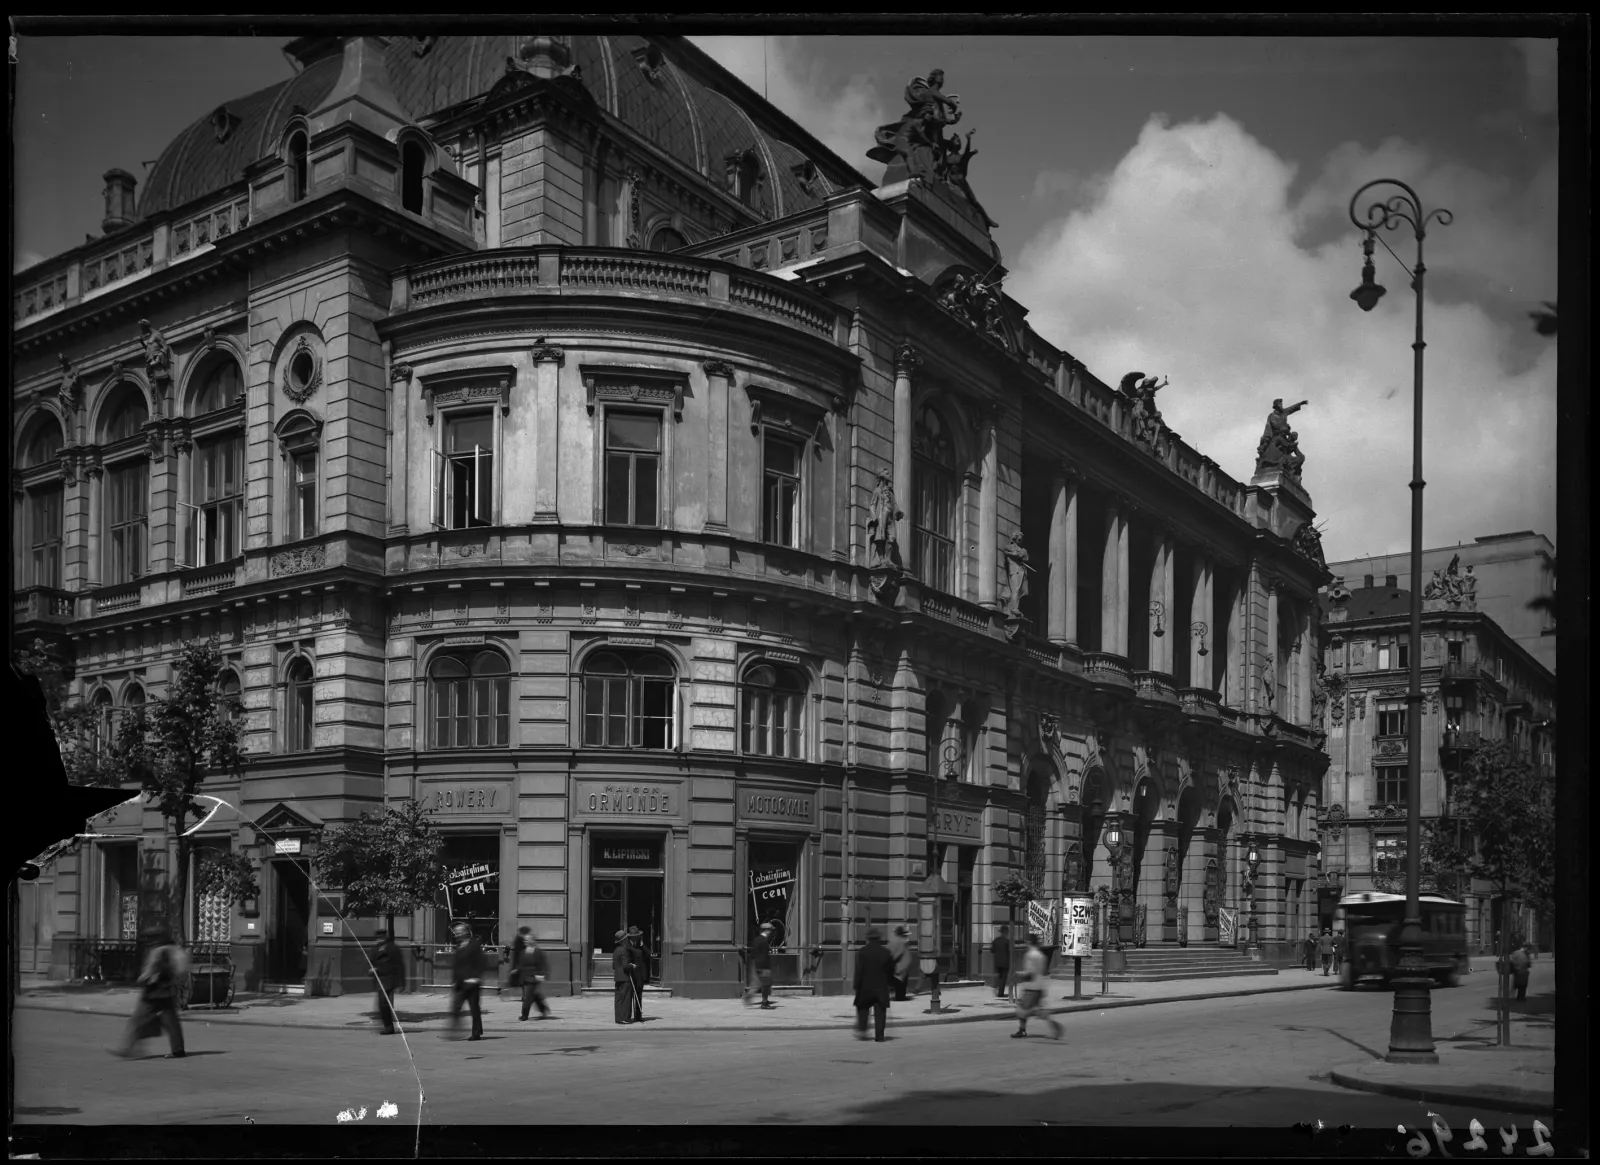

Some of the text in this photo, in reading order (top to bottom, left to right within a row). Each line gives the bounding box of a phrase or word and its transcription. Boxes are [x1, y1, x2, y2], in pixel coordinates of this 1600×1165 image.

[605, 786, 660, 794] MAISON
[436, 789, 497, 808] ROWERY
[588, 793, 669, 812] ORMONDE
[747, 795, 809, 817] MOTOCYKLE
[457, 882, 486, 896] ceny
[762, 887, 787, 900] ceny
